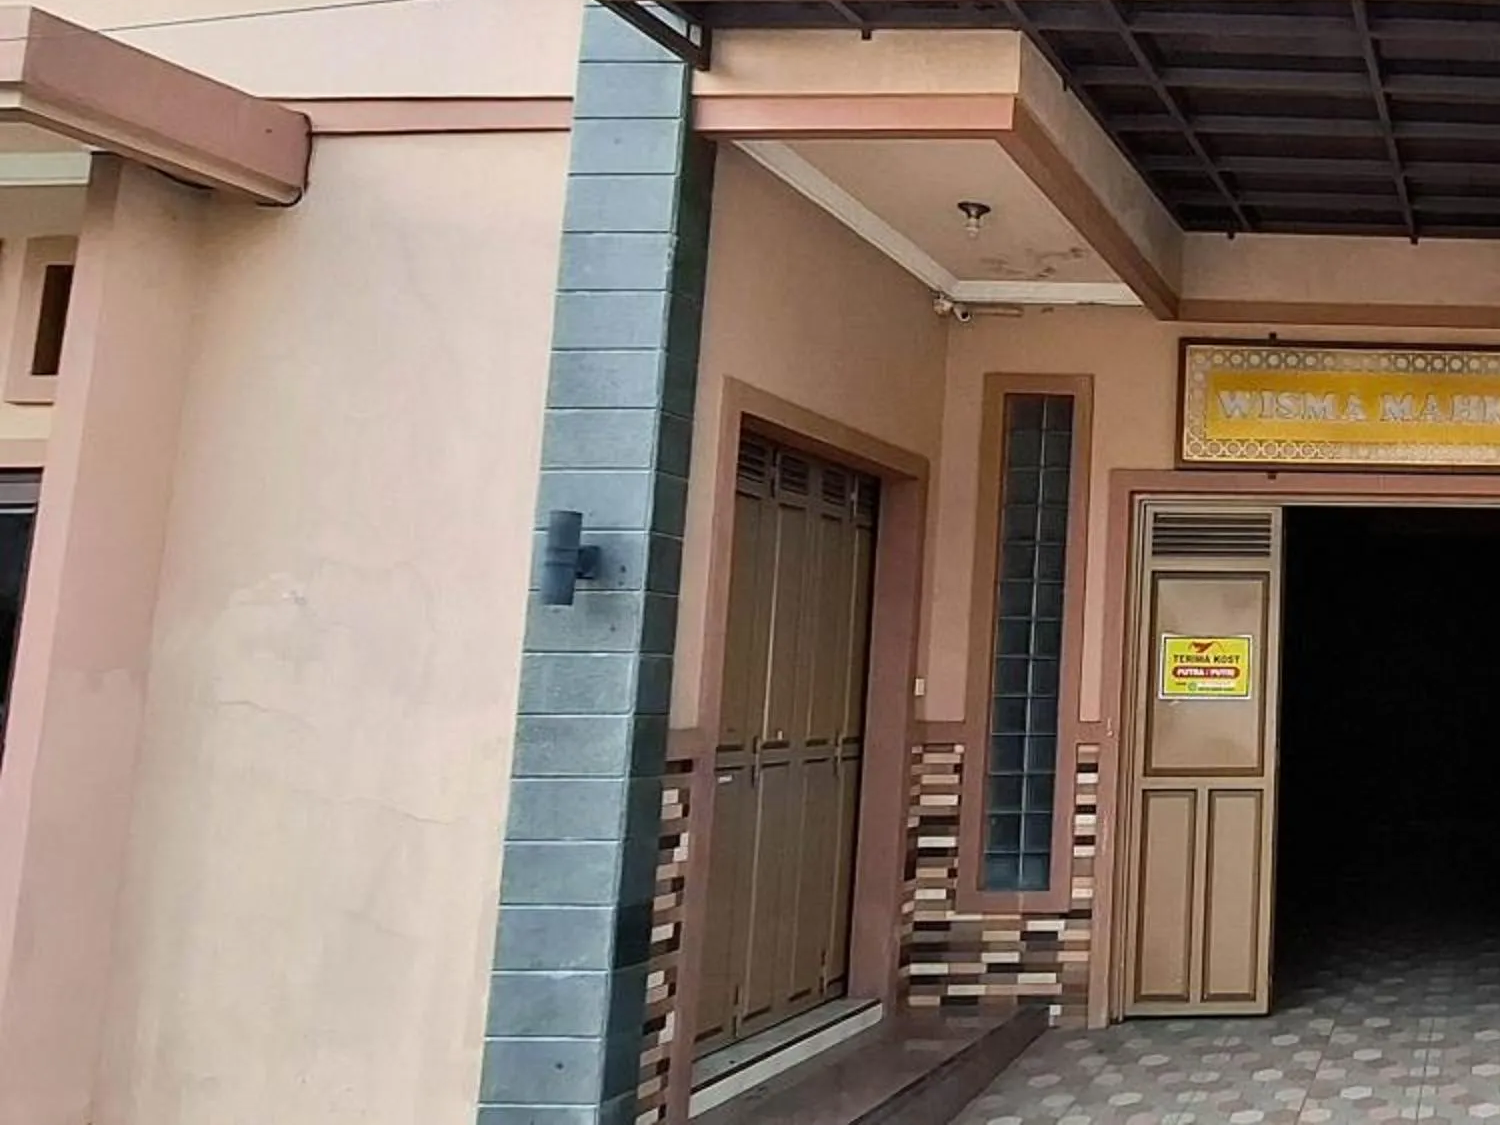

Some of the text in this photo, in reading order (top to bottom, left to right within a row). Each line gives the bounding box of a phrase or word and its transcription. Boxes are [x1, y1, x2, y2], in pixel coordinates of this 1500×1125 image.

[1218, 389, 1367, 422] WISMA
[1174, 655, 1240, 664] TERIMA KOST
